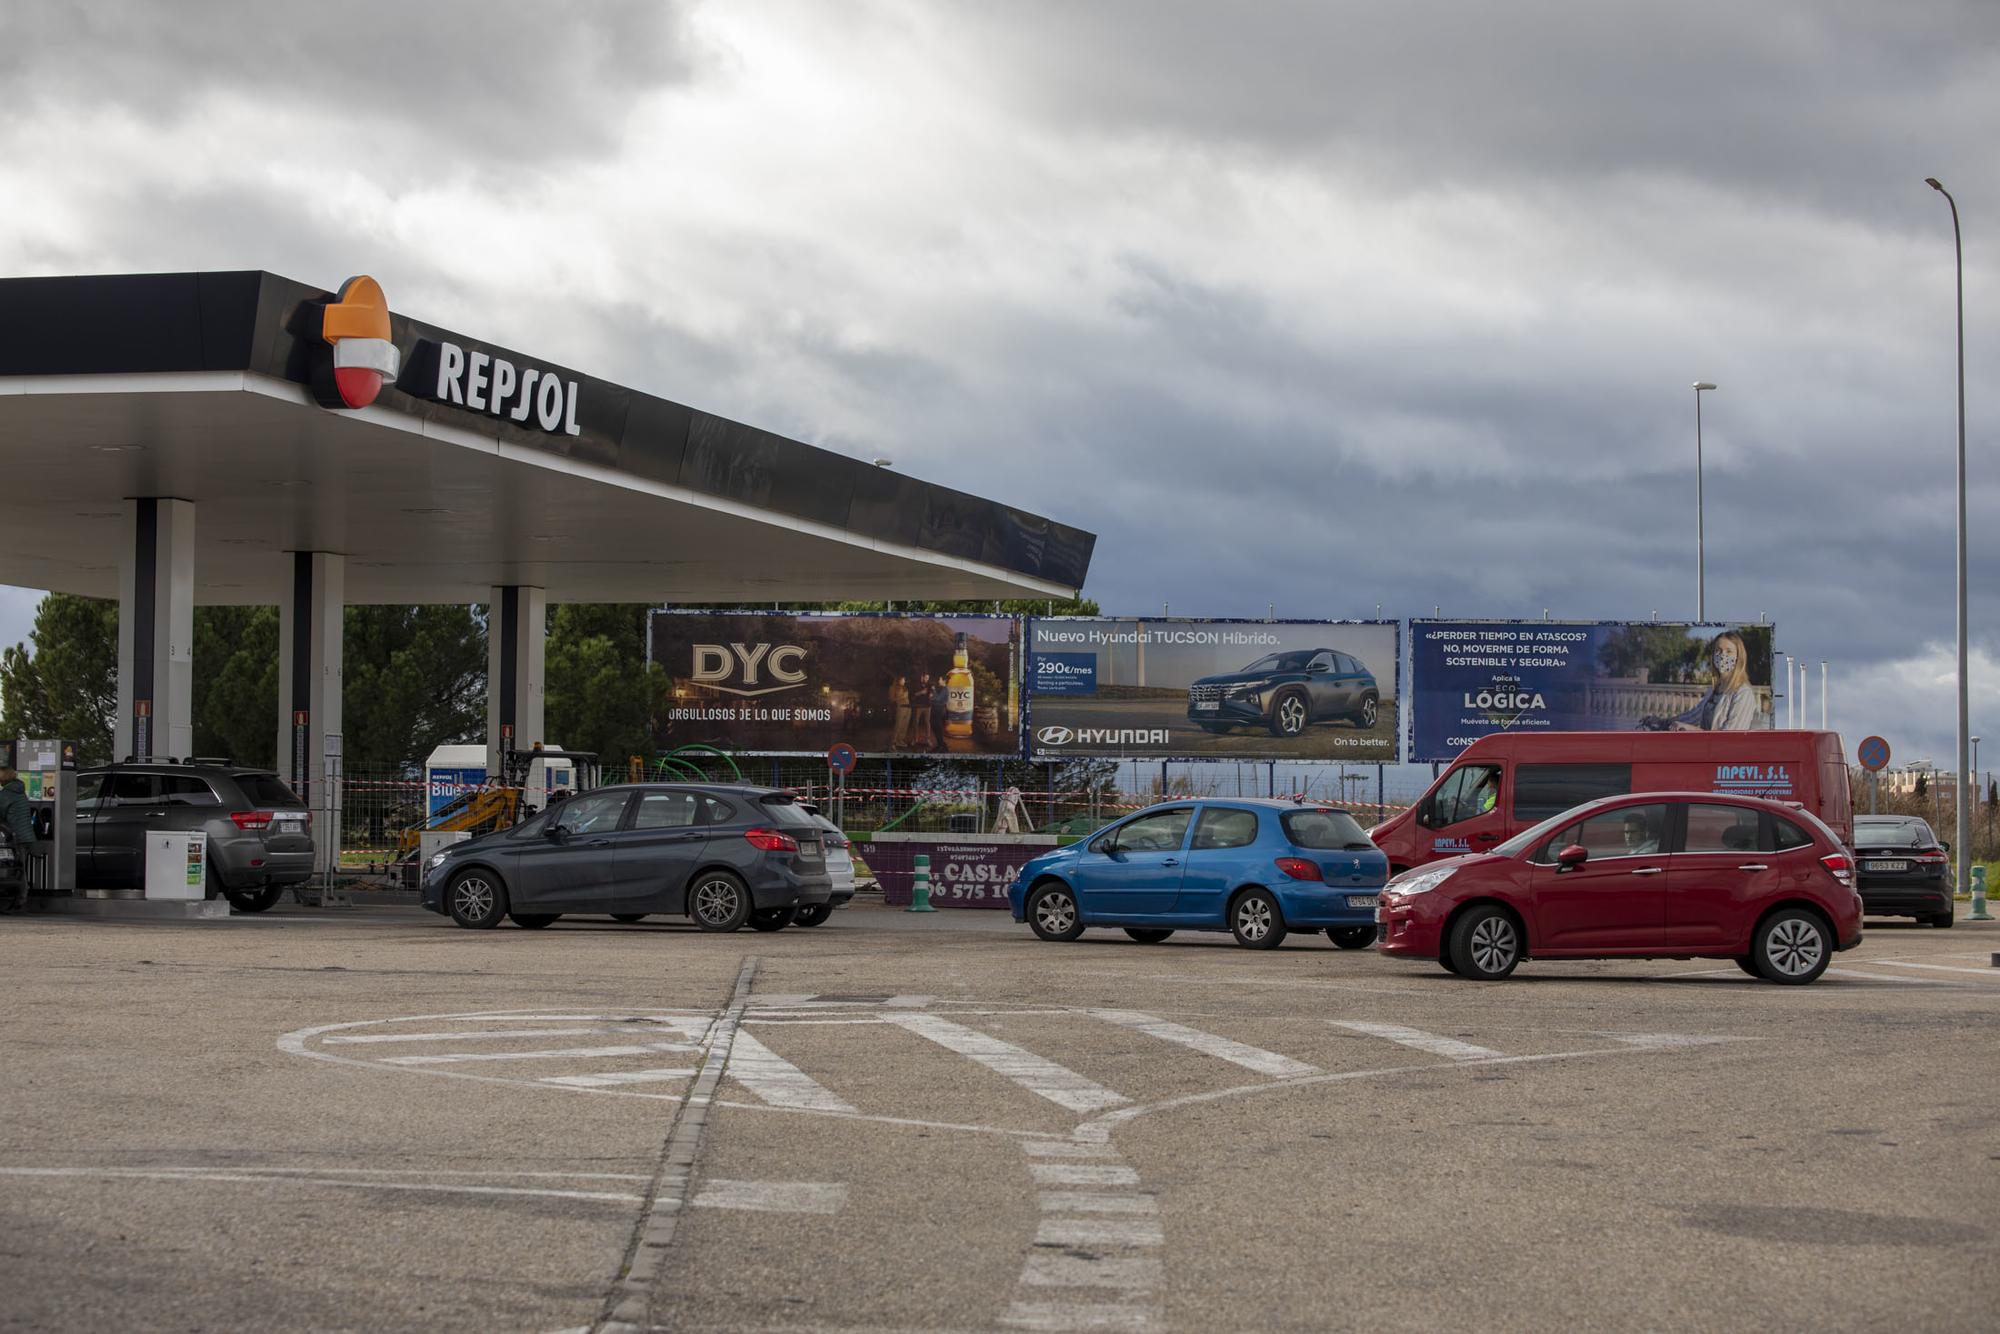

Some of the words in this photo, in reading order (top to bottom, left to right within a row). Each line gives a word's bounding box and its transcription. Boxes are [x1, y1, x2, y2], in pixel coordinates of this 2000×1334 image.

[437, 342, 580, 436] REPSOL
[1037, 630, 1085, 642] Nuevo
[1089, 630, 1152, 645] Hyundai
[1154, 631, 1218, 644] TUCSON
[1222, 632, 1280, 645] Híbrido.
[1478, 632, 1517, 640] TIEMPO
[1519, 632, 1533, 641] EN
[1536, 632, 1587, 641] ATASCOS?
[1443, 644, 1461, 654] NO,
[1462, 645, 1513, 654] MOVERME
[1516, 645, 1530, 654] DE
[1533, 645, 1569, 654] FORMA
[691, 643, 808, 685] DYC
[1037, 662, 1092, 674] 290€/mes
[1446, 657, 1507, 666] SOSTENIBLE
[1509, 658, 1517, 666] Y
[1519, 658, 1566, 667] SEGURA»
[950, 691, 970, 699] DYC
[1464, 690, 1546, 709] LÓGICA
[668, 708, 736, 721] ORGULLOSOS
[754, 709, 768, 721] LO
[771, 709, 791, 721] QUE
[794, 709, 831, 721] SOMOS
[1521, 718, 1551, 726] eficiente
[1077, 729, 1169, 744] HYUNDAI
[1334, 737, 1348, 746] On
[1349, 738, 1359, 746] to
[1360, 738, 1390, 746] better.
[952, 884, 985, 899] 575
